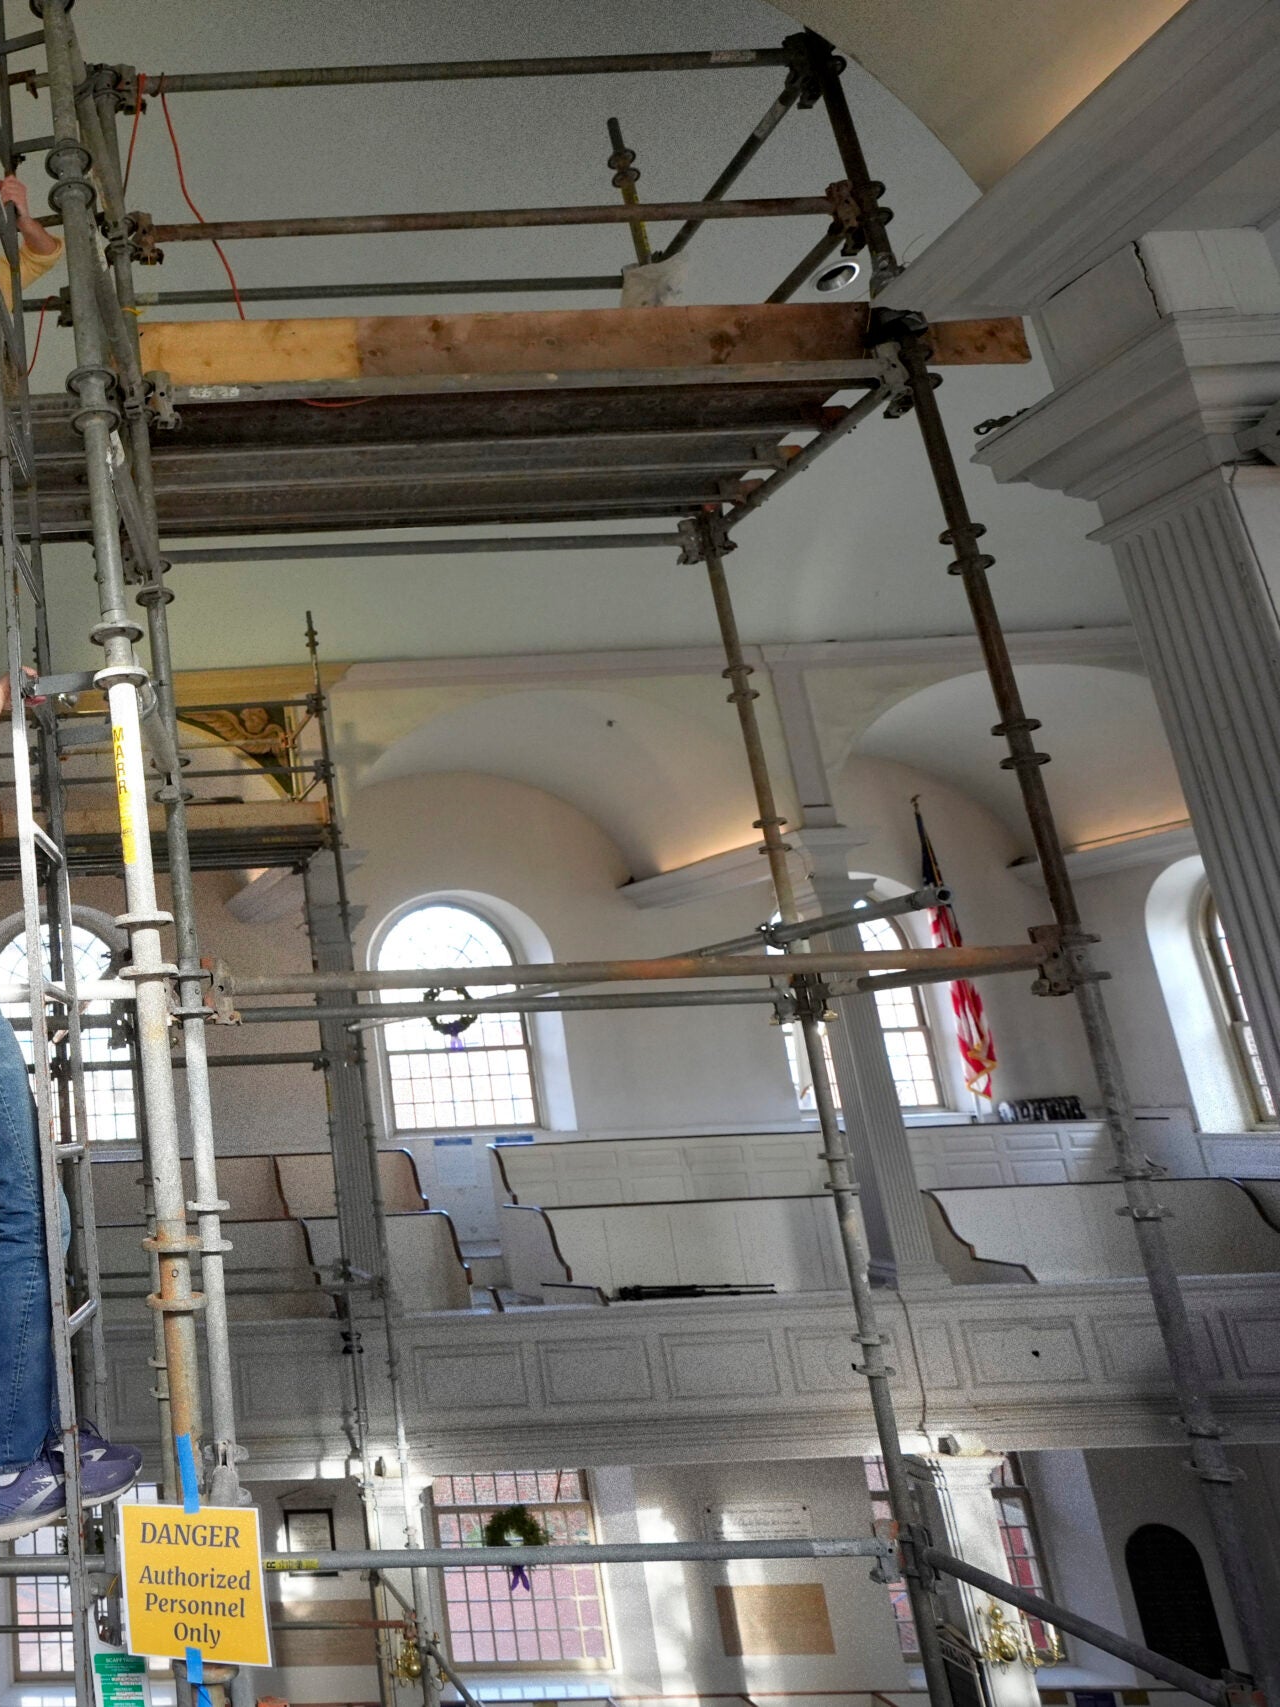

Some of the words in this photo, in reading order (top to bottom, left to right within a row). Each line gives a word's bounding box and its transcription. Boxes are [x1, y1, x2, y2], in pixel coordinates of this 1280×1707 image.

[113, 727, 128, 795] MARR
[140, 1522, 240, 1548] DANGER
[138, 1565, 251, 1591] Authorized
[145, 1592, 245, 1618] Personnel
[174, 1622, 220, 1649] Only
